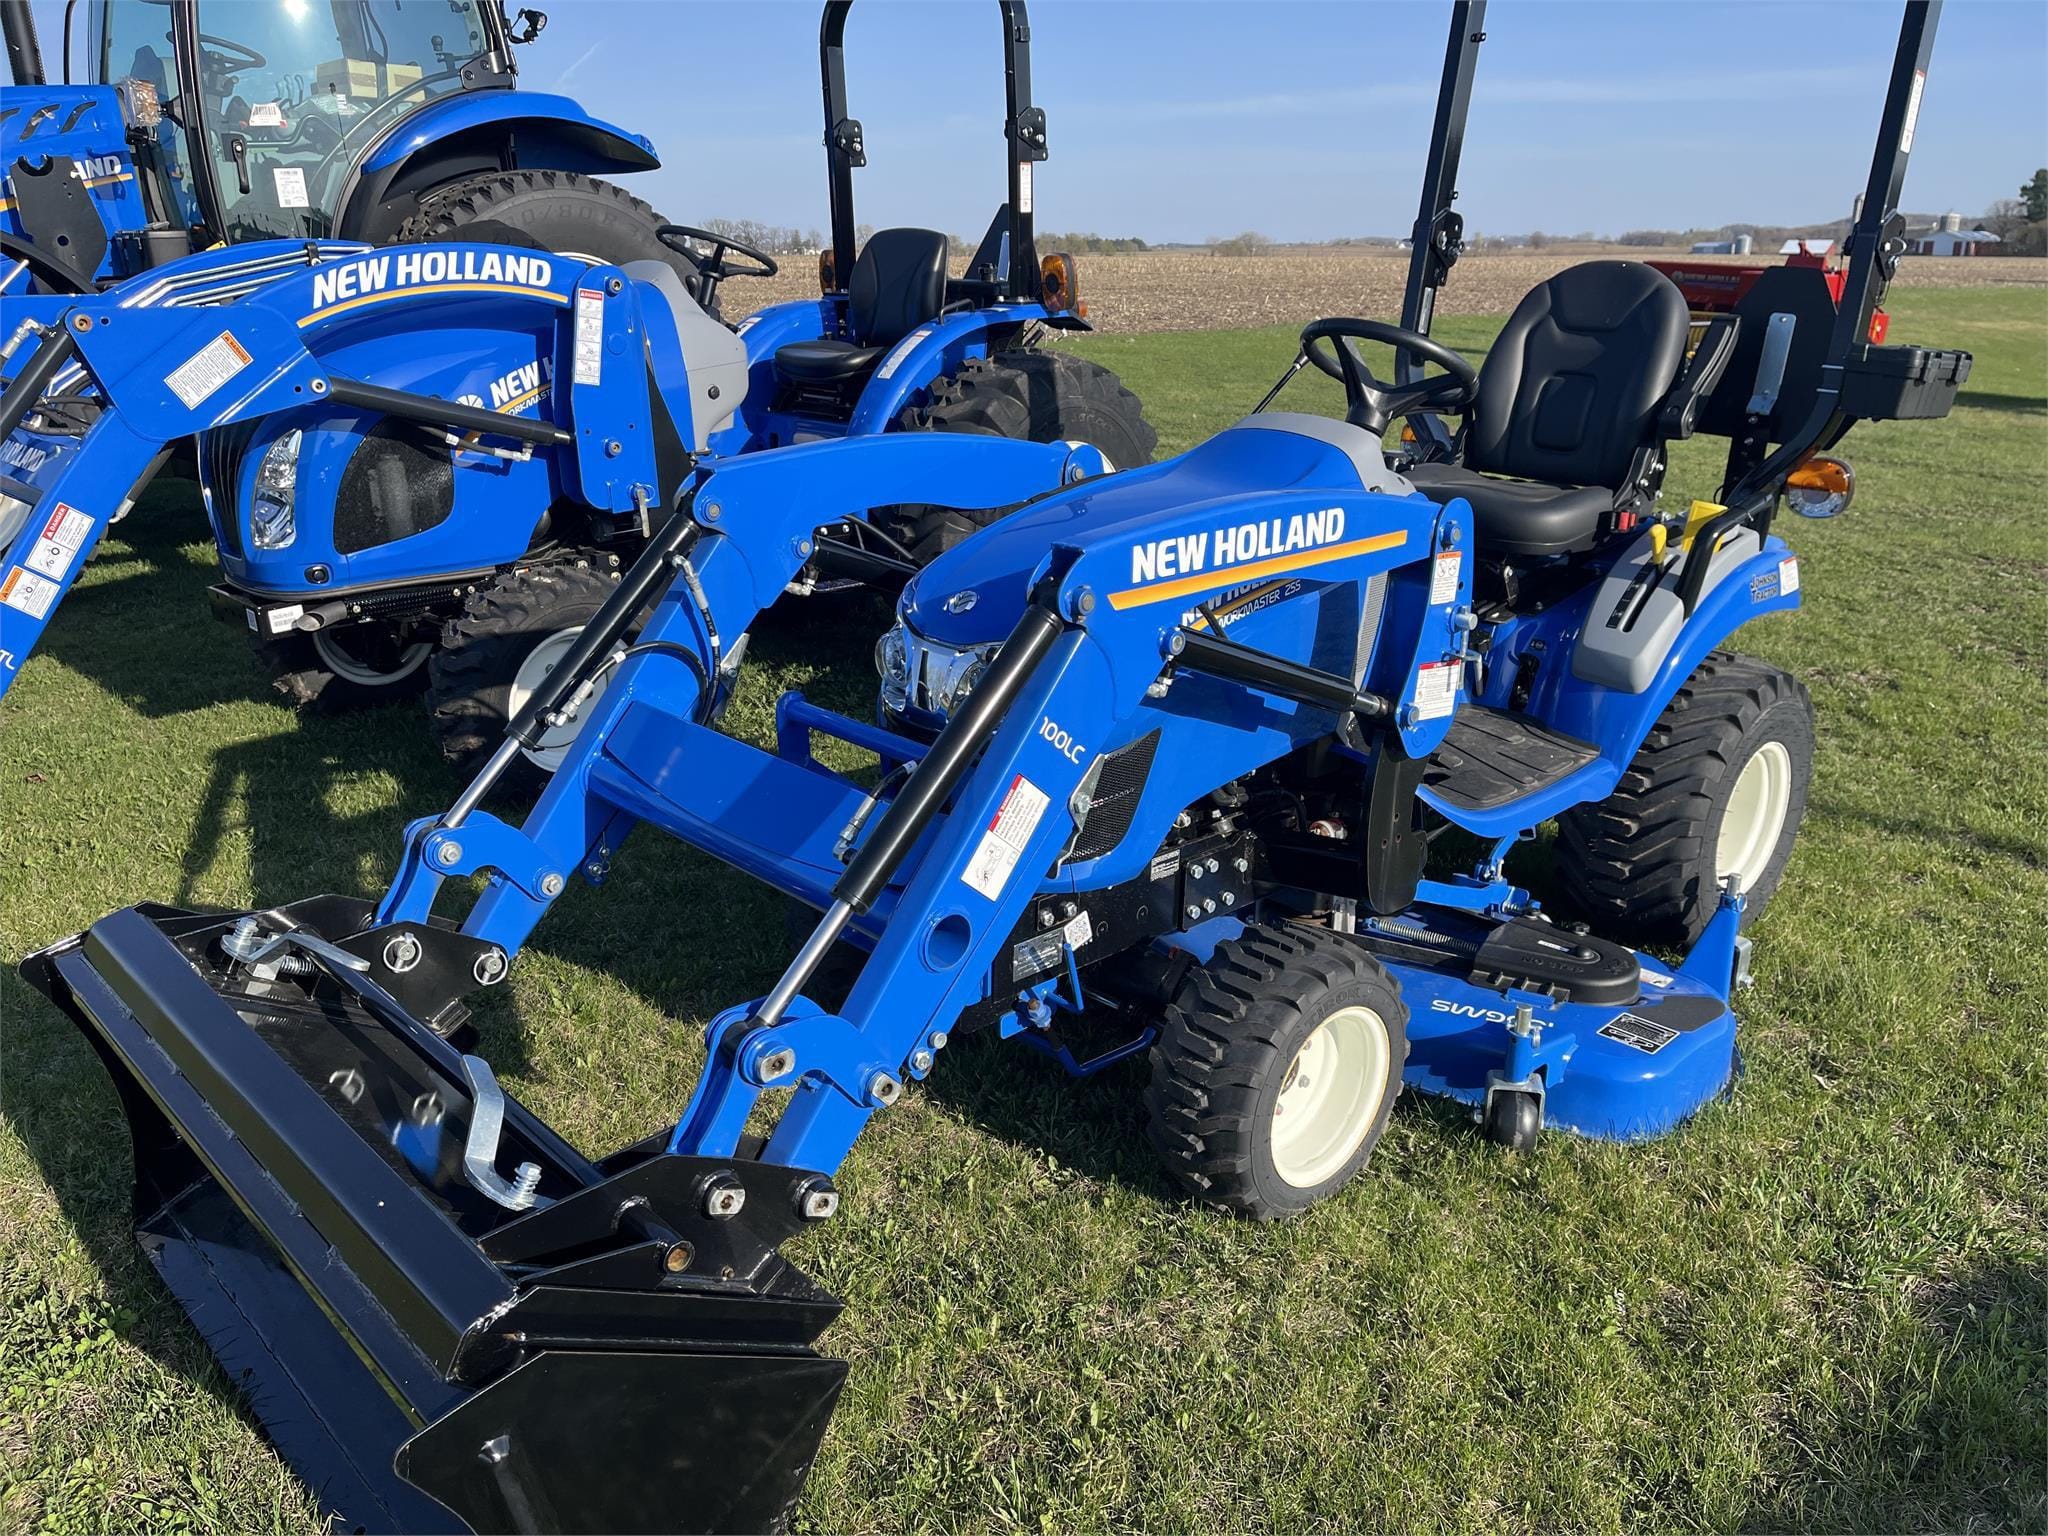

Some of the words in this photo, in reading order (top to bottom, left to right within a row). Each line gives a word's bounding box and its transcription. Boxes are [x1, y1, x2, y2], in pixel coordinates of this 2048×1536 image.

[313, 256, 389, 309] NEW
[396, 252, 551, 287] HOLLAND
[490, 360, 538, 408] NEW
[49, 507, 66, 532] DANGER
[1132, 532, 1208, 583] NEW
[1213, 507, 1345, 566] HOLLAND
[1218, 589, 1280, 628] WORKMASTER
[1038, 716, 1086, 764] 100LC
